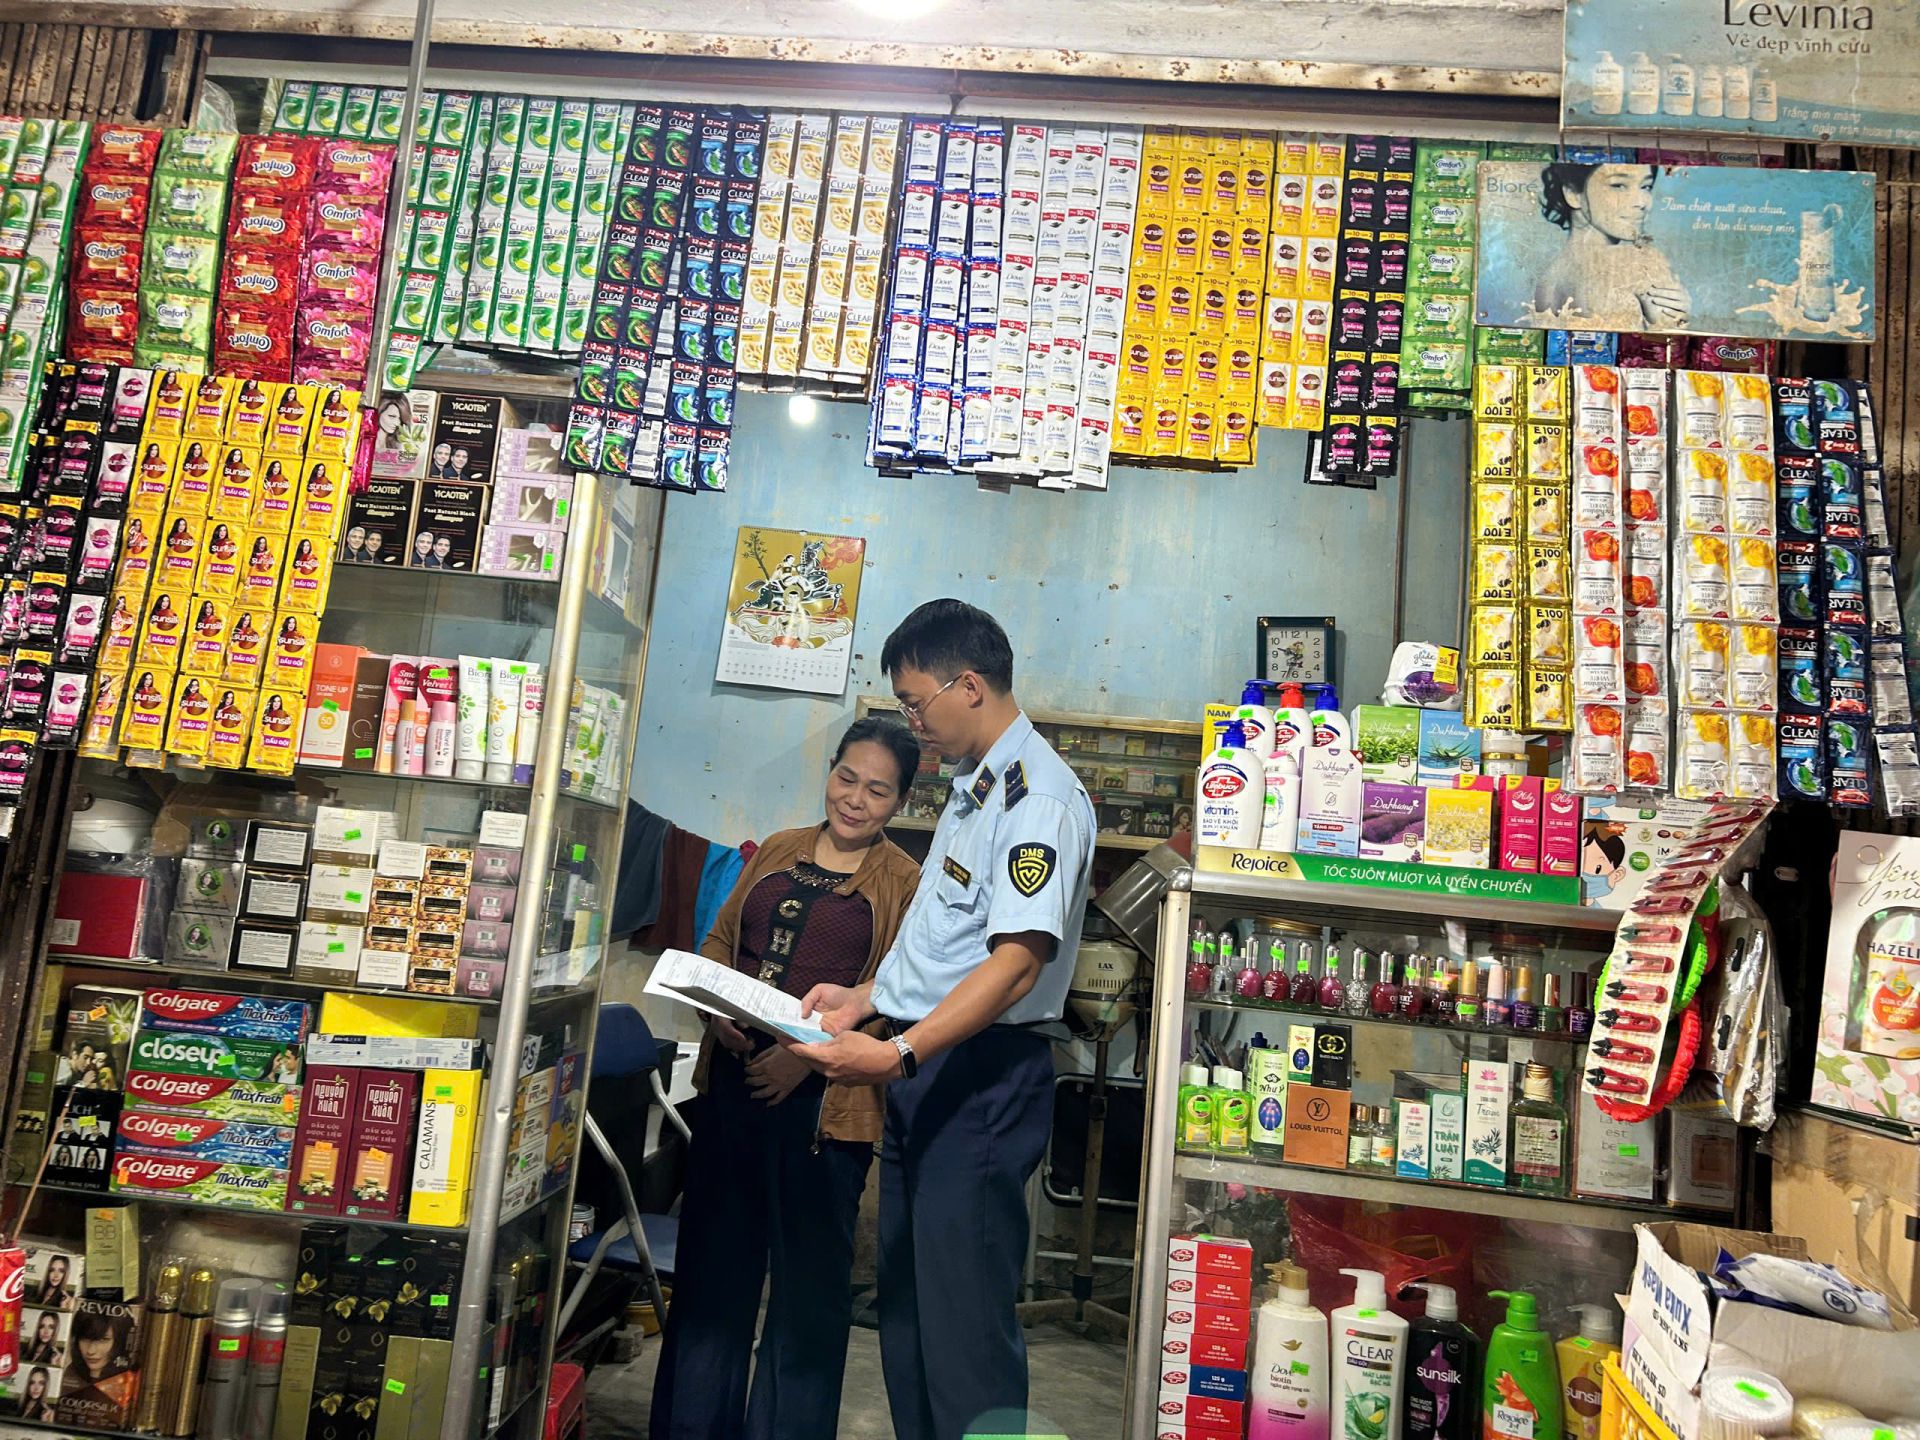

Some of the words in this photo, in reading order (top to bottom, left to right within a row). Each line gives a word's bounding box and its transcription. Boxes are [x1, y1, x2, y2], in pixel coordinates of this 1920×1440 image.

[1724, 0, 1872, 30] Levinia
[1757, 36, 1788, 53] đẹp
[1795, 37, 1832, 52] vĩnh
[562, 103, 587, 112] CLEAR
[637, 114, 661, 125] CLEAR
[839, 118, 865, 128] CLEAR
[735, 130, 760, 140] CLEAR
[769, 126, 794, 136] CLEAR
[103, 132, 143, 143] Comfort
[332, 151, 372, 163] Comfort
[254, 162, 295, 176] Comfort
[1434, 159, 1463, 169] Comfort
[586, 167, 609, 176] CLEAR
[624, 172, 649, 183] CLEAR
[830, 179, 856, 190] CLEAR
[1351, 187, 1374, 196] sunsilk
[322, 205, 363, 219] Comfort
[244, 218, 284, 232] Comfort
[611, 231, 636, 243] CLEAR
[85, 242, 126, 255] Comfort
[1428, 254, 1457, 265] Comfort
[316, 264, 356, 277] Comfort
[236, 277, 277, 290] Comfort
[598, 291, 624, 301] CLEAR
[310, 323, 351, 336] Comfort
[1421, 350, 1449, 361] Comfort
[1716, 345, 1758, 361] Comfort
[707, 375, 734, 385] CLEAR
[1820, 429, 1857, 440] CLEAR
[1779, 467, 1816, 479] CLEAR
[30, 593, 60, 603] sunsilk
[1448, 653, 1457, 666] 1
[14, 672, 45, 682] sunsilk
[336, 685, 348, 693] UP
[1020, 848, 1044, 858] DMS
[1231, 853, 1288, 873] Rejoice
[1324, 864, 1347, 877] TÓC
[1427, 874, 1442, 886] VÀ
[148, 992, 220, 1012] Colgate
[139, 1038, 225, 1071] closeup
[131, 1074, 210, 1096] Colgate
[122, 1116, 202, 1138] Colgate
[419, 1098, 437, 1170] CALAMANSI
[117, 1157, 196, 1179] Colgate
[77, 1302, 135, 1317] REVLON
[1346, 1340, 1393, 1361] CLEAR
[1270, 1374, 1292, 1384] biotin
[1416, 1366, 1462, 1384] sunsilk
